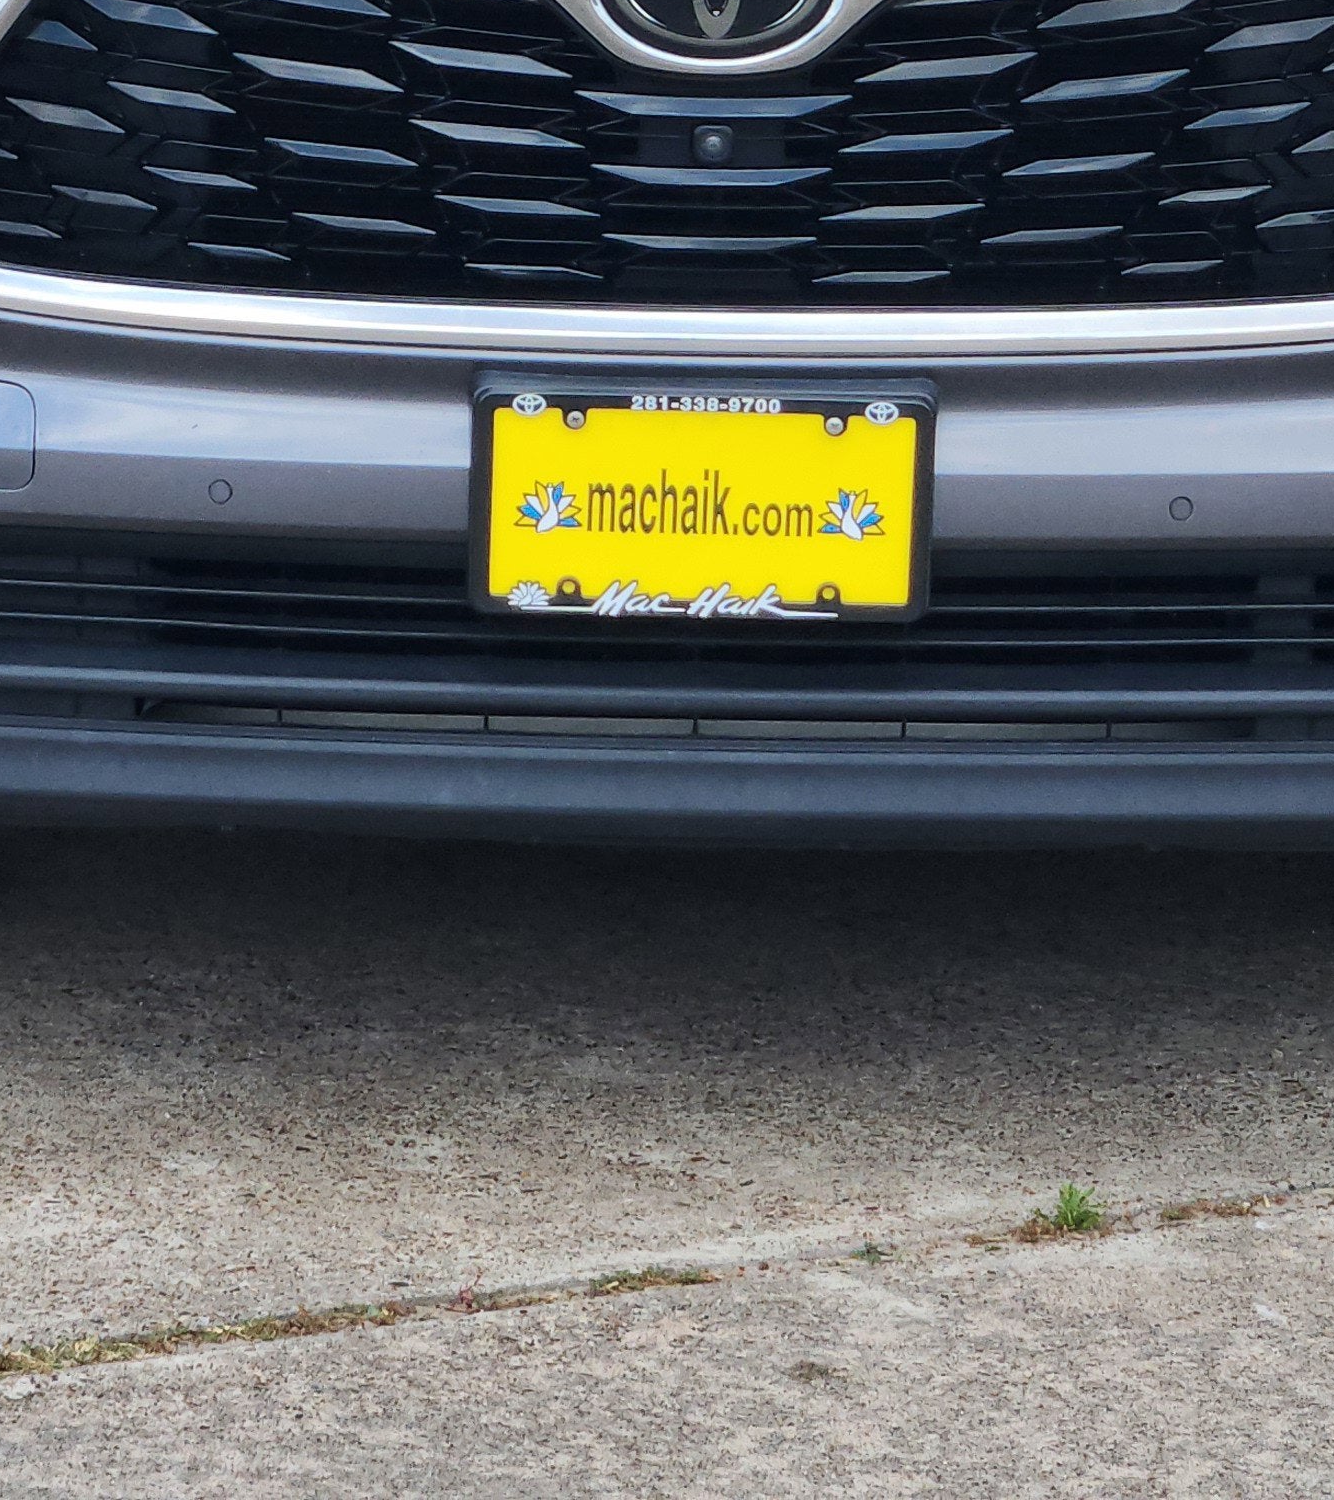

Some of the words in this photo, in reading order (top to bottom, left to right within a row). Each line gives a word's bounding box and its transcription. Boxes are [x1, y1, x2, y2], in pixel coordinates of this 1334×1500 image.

[630, 394, 782, 414] 281-338-9700
[586, 469, 814, 538] machaik.com
[590, 579, 675, 618] Mac
[683, 582, 785, 618] Haik
